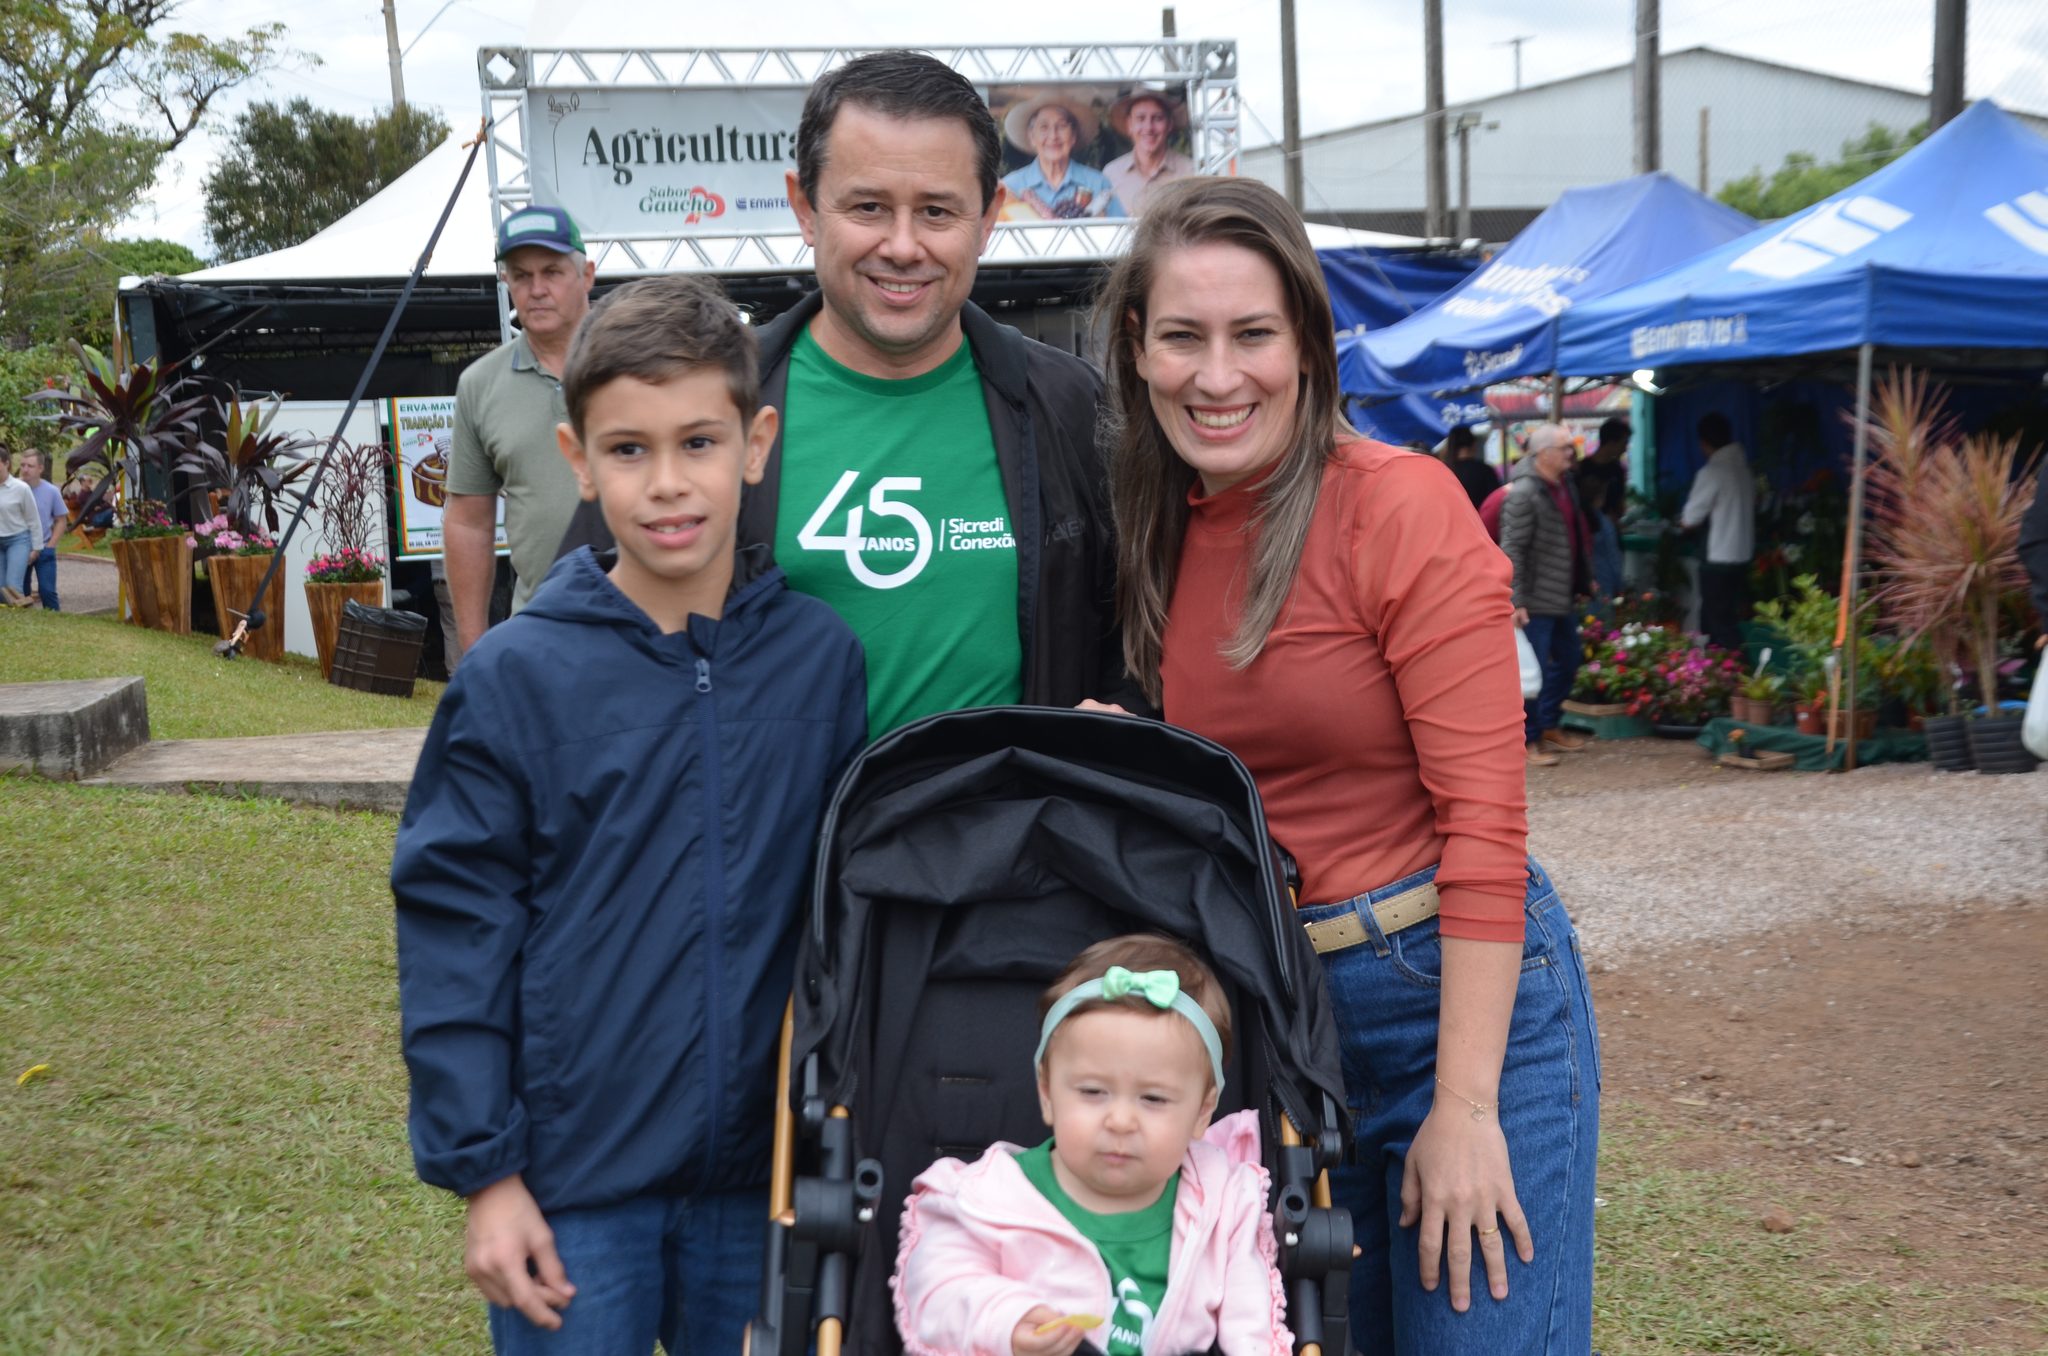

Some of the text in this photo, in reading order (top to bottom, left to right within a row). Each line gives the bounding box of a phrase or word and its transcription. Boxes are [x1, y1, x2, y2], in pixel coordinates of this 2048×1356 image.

[649, 186, 691, 199] Sabor
[797, 470, 933, 590] 45
[948, 517, 1004, 534] Sicredi
[867, 537, 916, 552] ANOS
